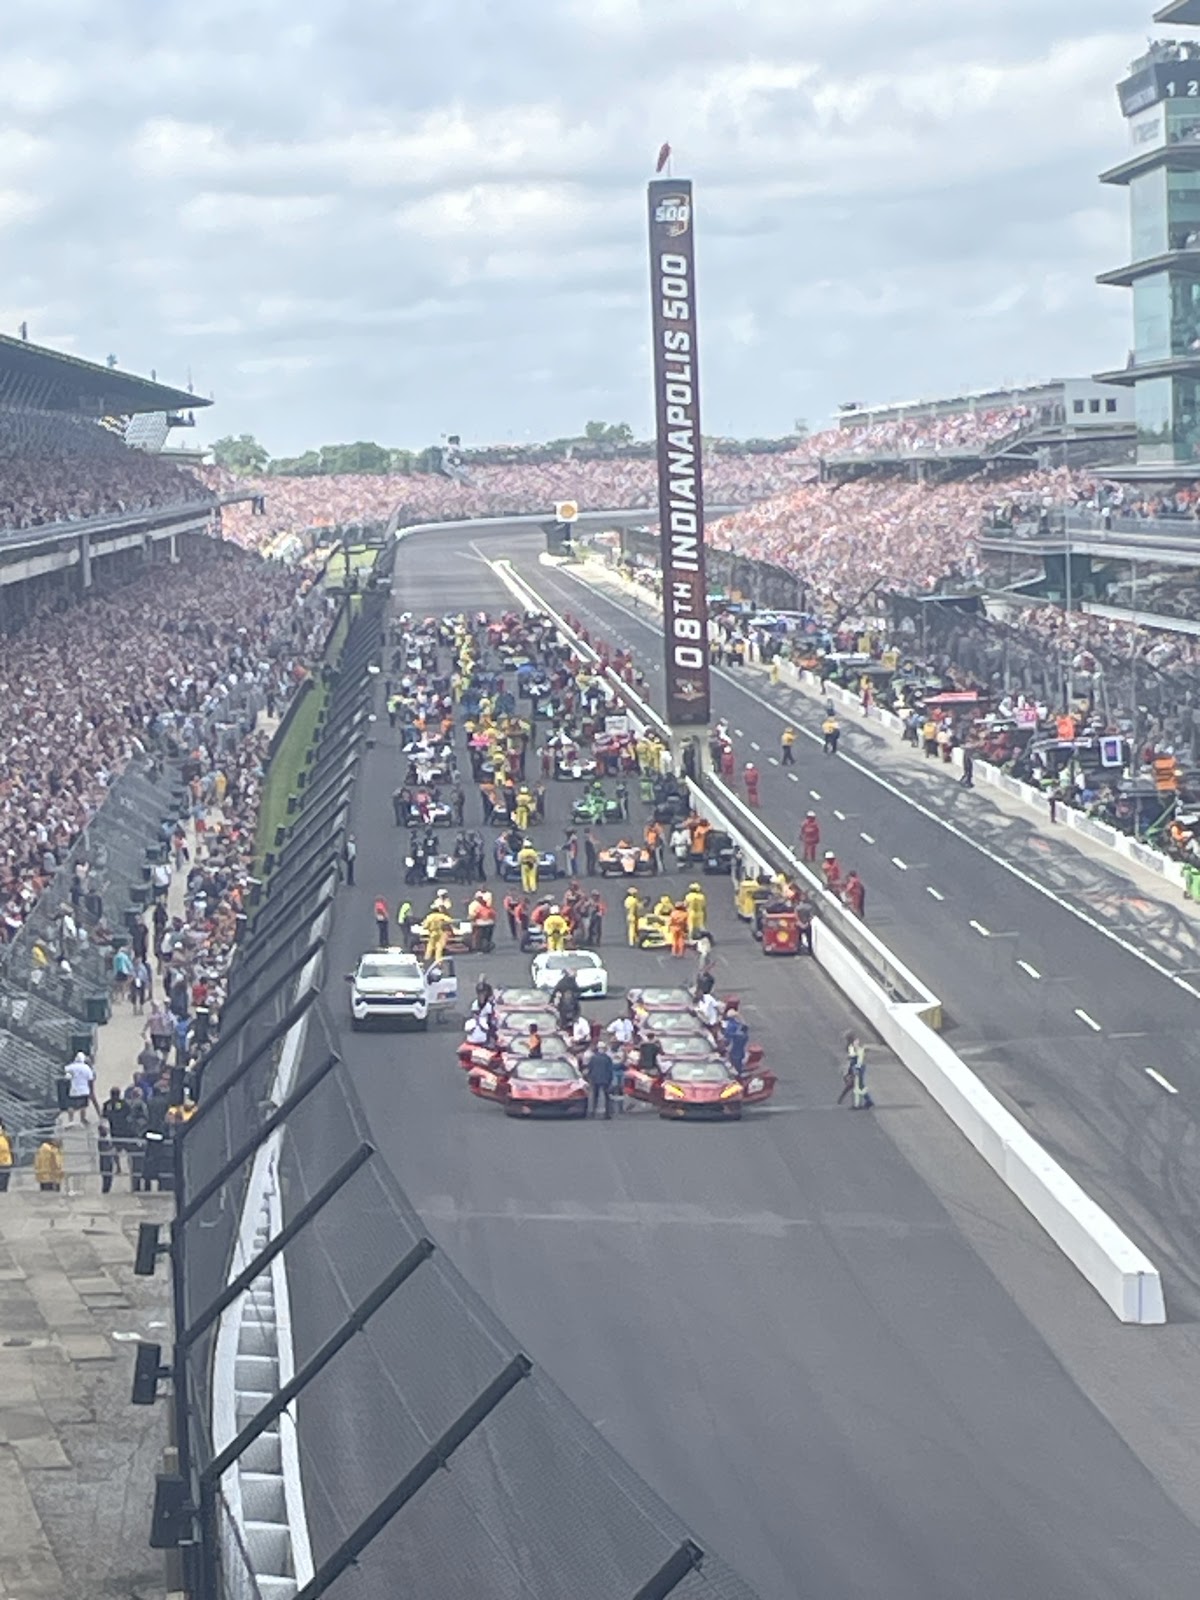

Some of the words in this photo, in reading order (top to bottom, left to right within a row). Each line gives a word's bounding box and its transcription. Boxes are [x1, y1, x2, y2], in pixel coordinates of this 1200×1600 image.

[1166, 81, 1175, 97] 1
[1187, 80, 1198, 96] 2
[655, 206, 689, 222] 500
[661, 253, 689, 320] 500
[664, 330, 699, 572] INDIANAPOLIS
